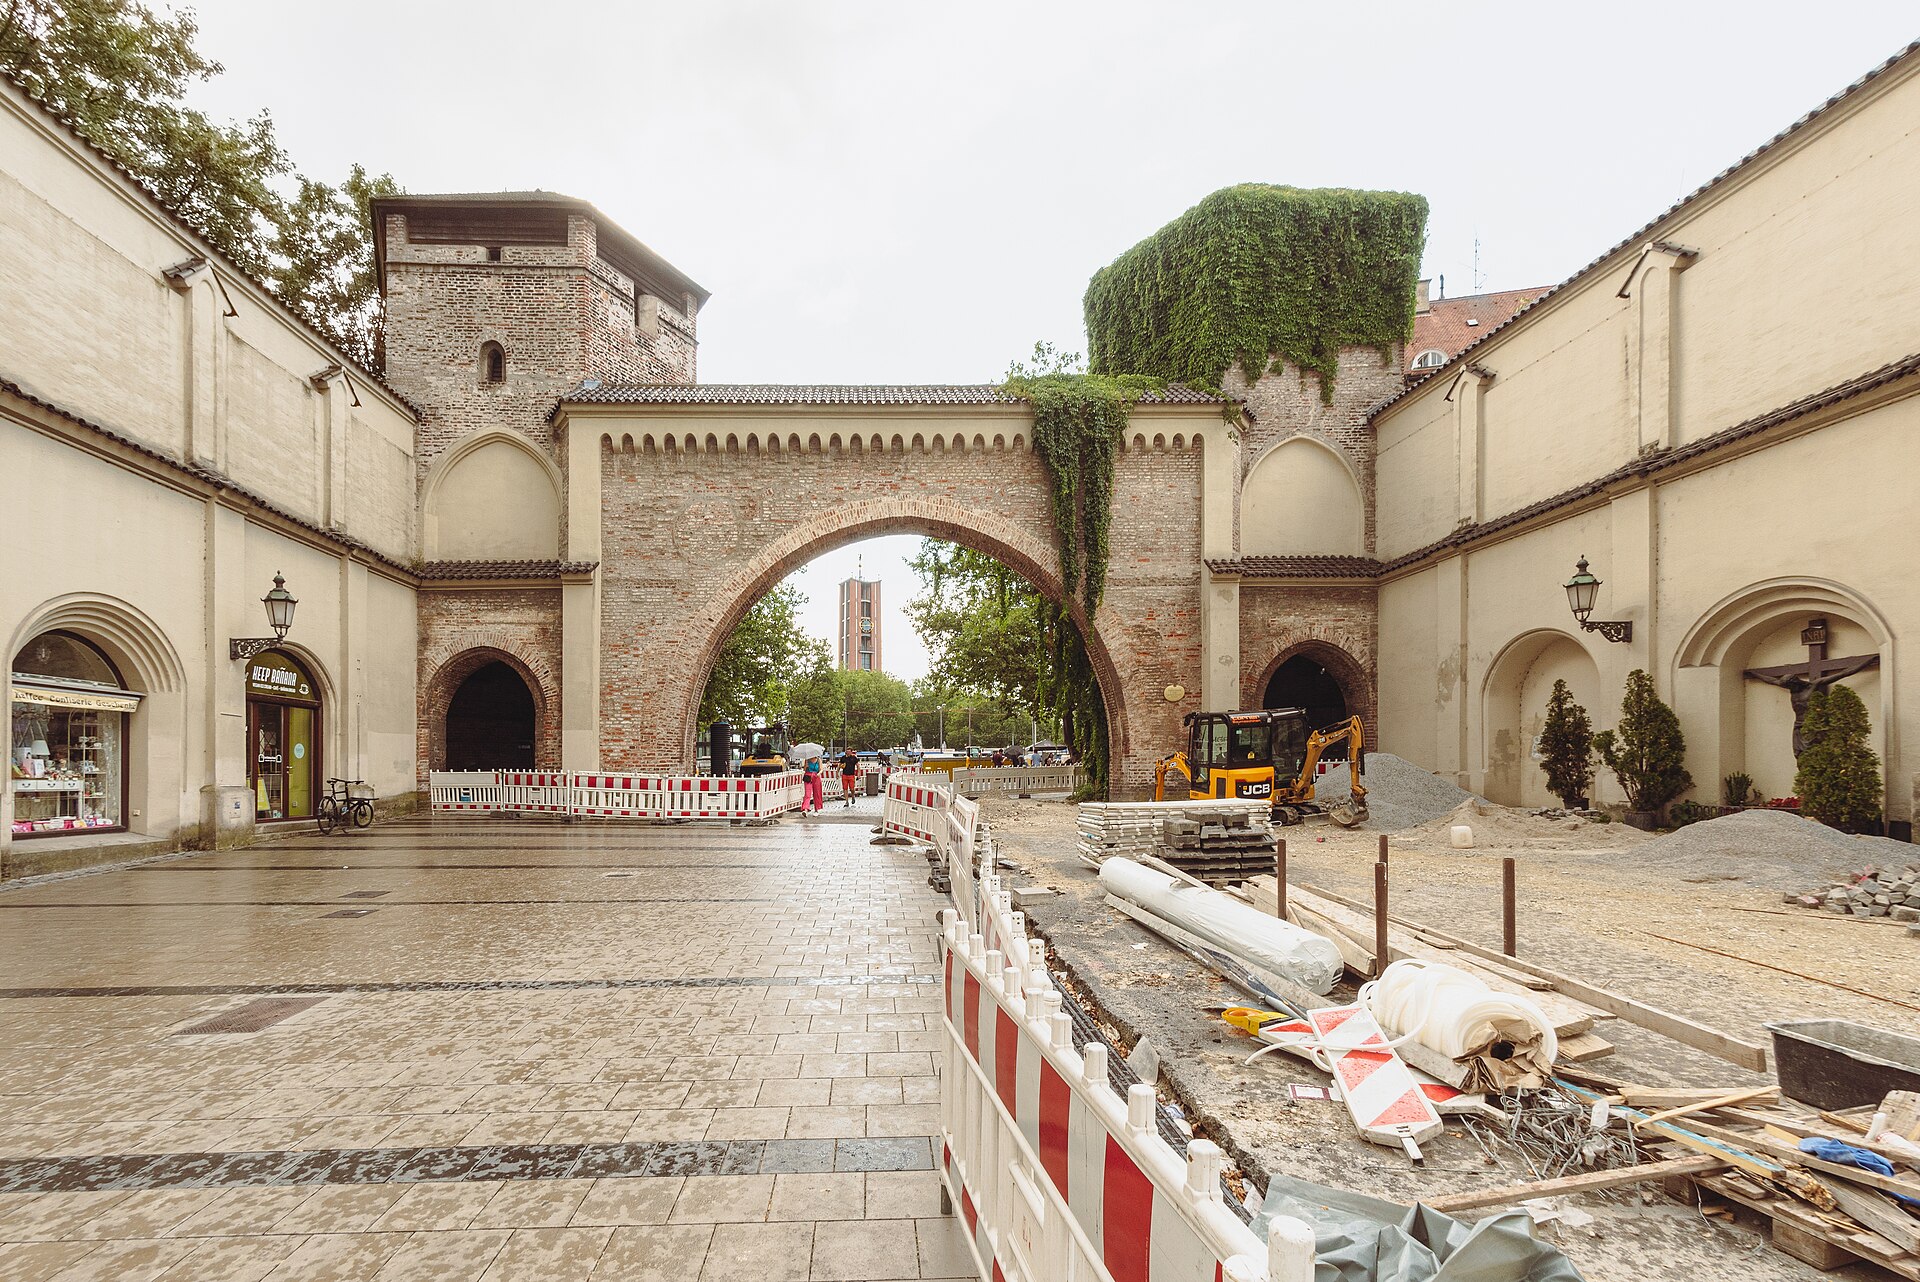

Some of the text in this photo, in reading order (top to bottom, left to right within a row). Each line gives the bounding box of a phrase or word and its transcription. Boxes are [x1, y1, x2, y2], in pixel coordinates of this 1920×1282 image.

[1802, 630, 1824, 641] INRI
[252, 665, 271, 682] KEEP
[271, 666, 297, 687] BAÑANA
[15, 691, 44, 701] Kaffee
[49, 695, 92, 706] Confiserie
[1242, 783, 1271, 796] JCB
